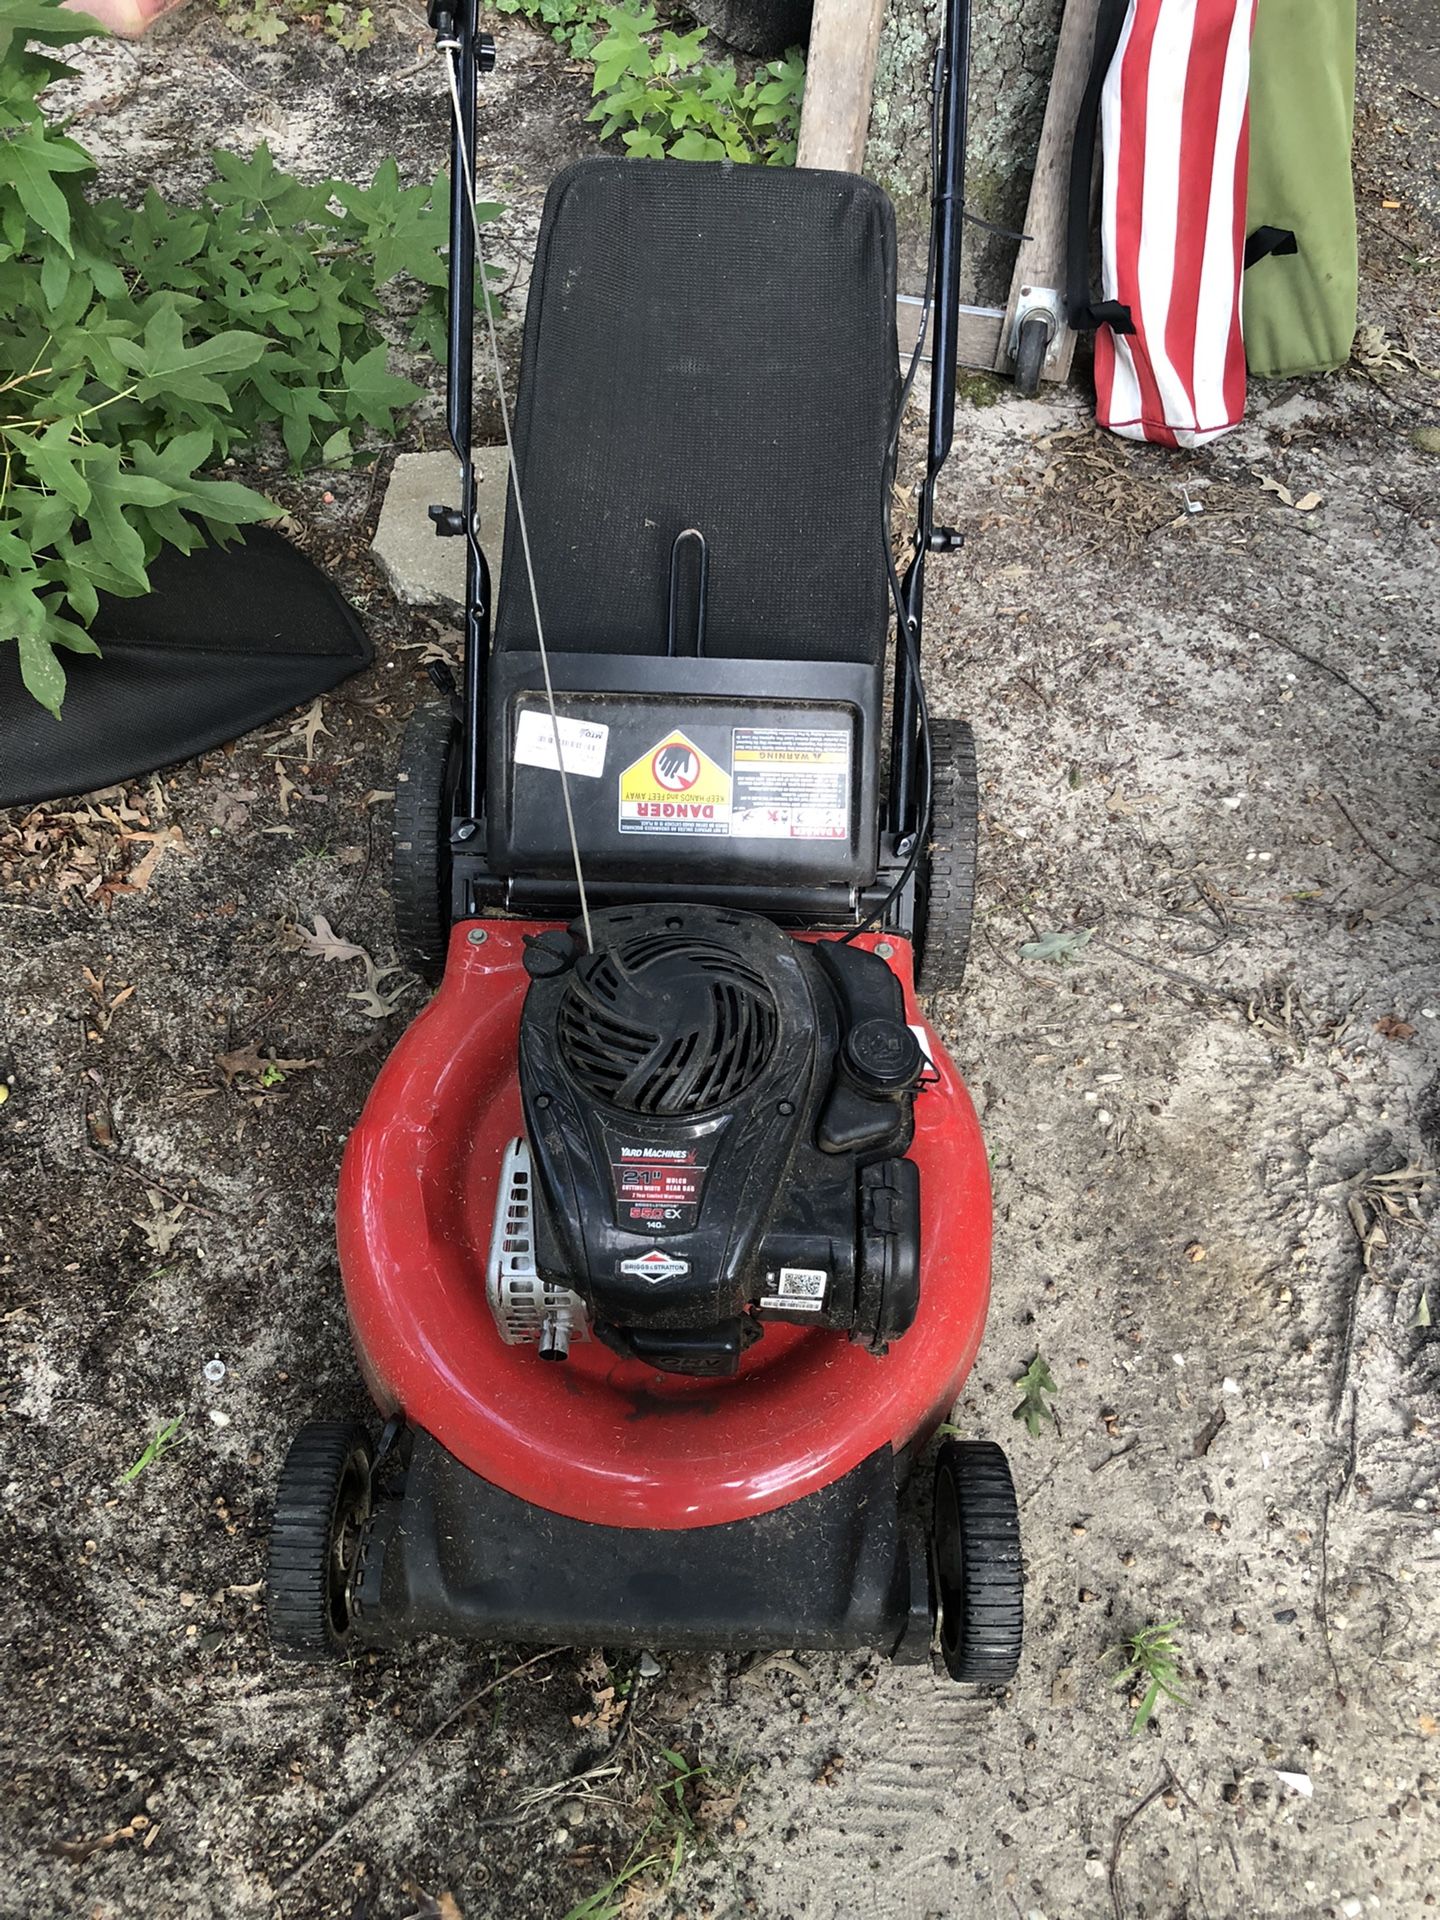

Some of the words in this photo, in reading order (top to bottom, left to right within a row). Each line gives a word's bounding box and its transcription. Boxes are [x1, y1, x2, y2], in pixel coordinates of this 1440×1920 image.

[759, 752, 810, 760] WARNING
[625, 792, 646, 800] AWAY
[637, 803, 714, 818] DANGER
[621, 1147, 643, 1157] YARD
[643, 1148, 687, 1158] MACHINES
[622, 1169, 661, 1185] 21"
